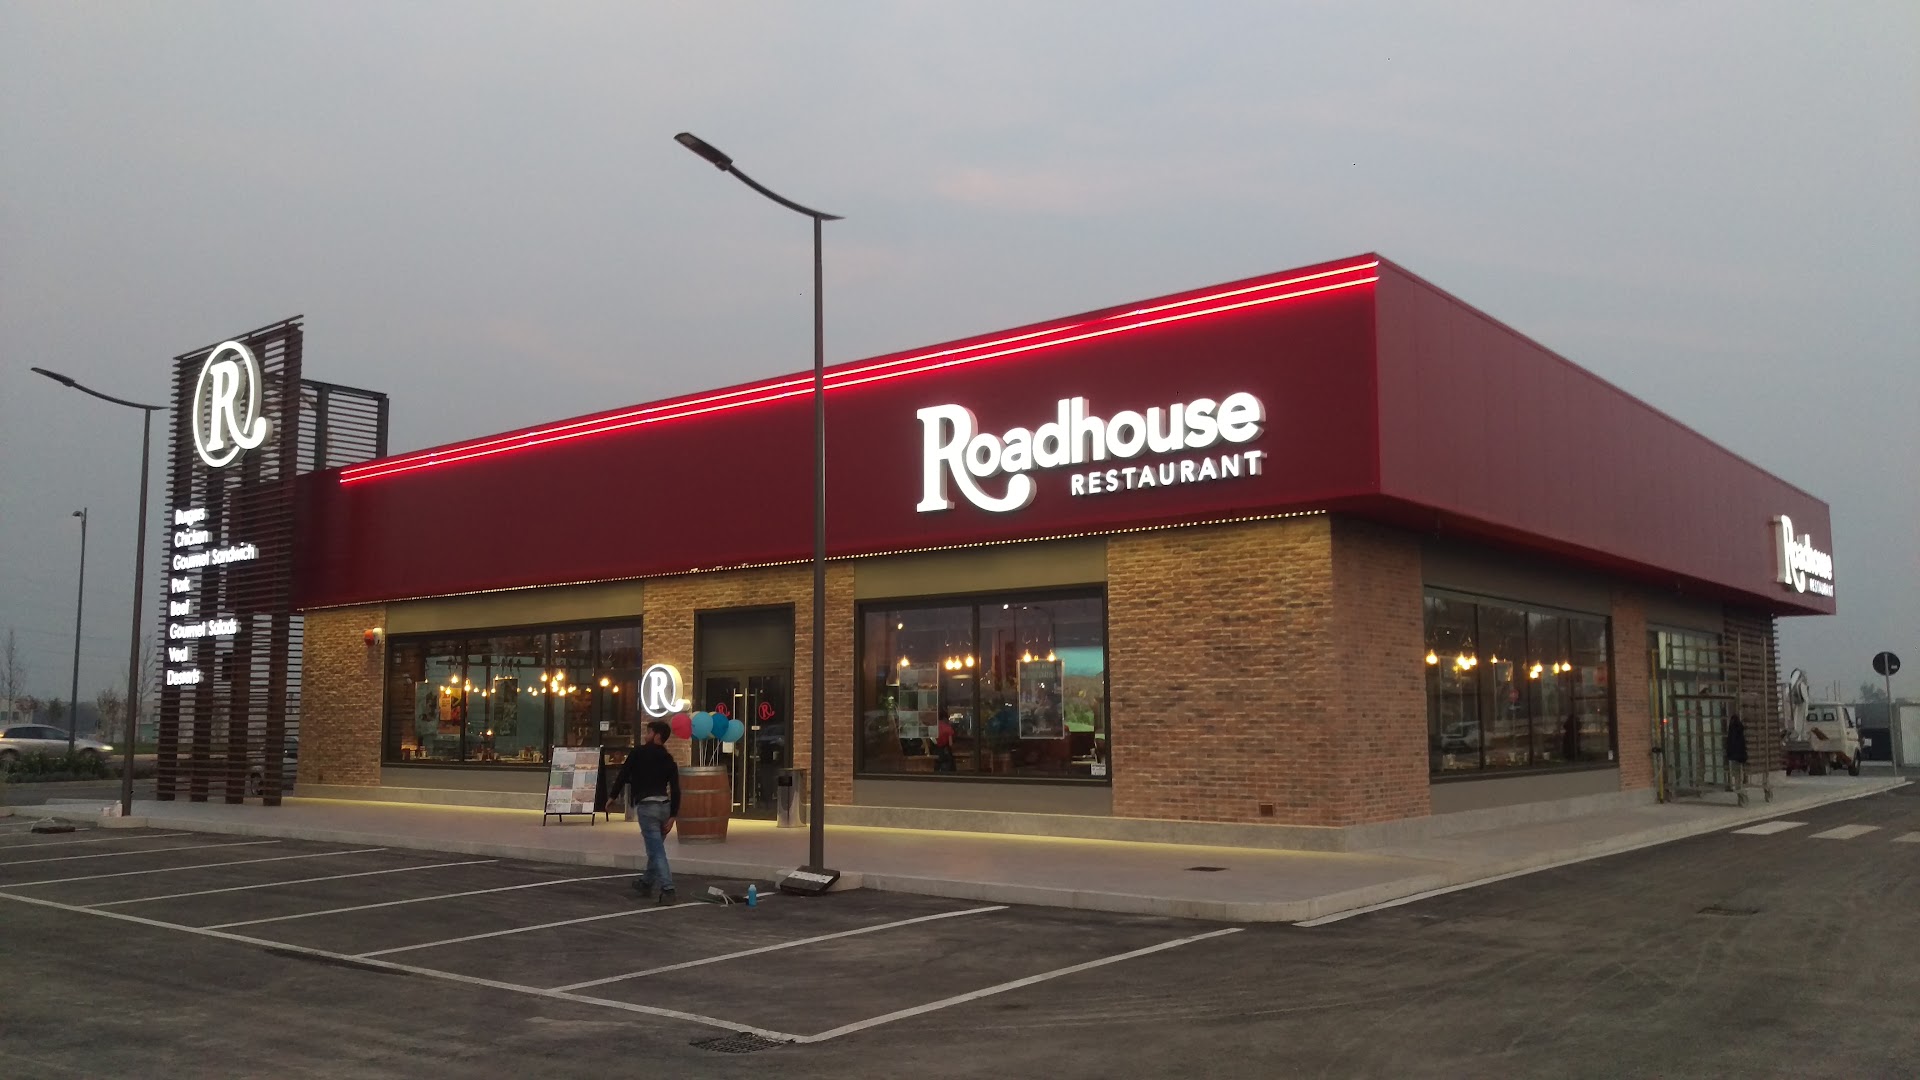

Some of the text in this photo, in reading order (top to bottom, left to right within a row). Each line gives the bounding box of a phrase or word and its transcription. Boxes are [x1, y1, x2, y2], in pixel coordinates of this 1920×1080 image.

[916, 392, 1262, 513] Roadhouse
[1071, 450, 1263, 496] RESTAURANT
[211, 541, 255, 565] Sandwich
